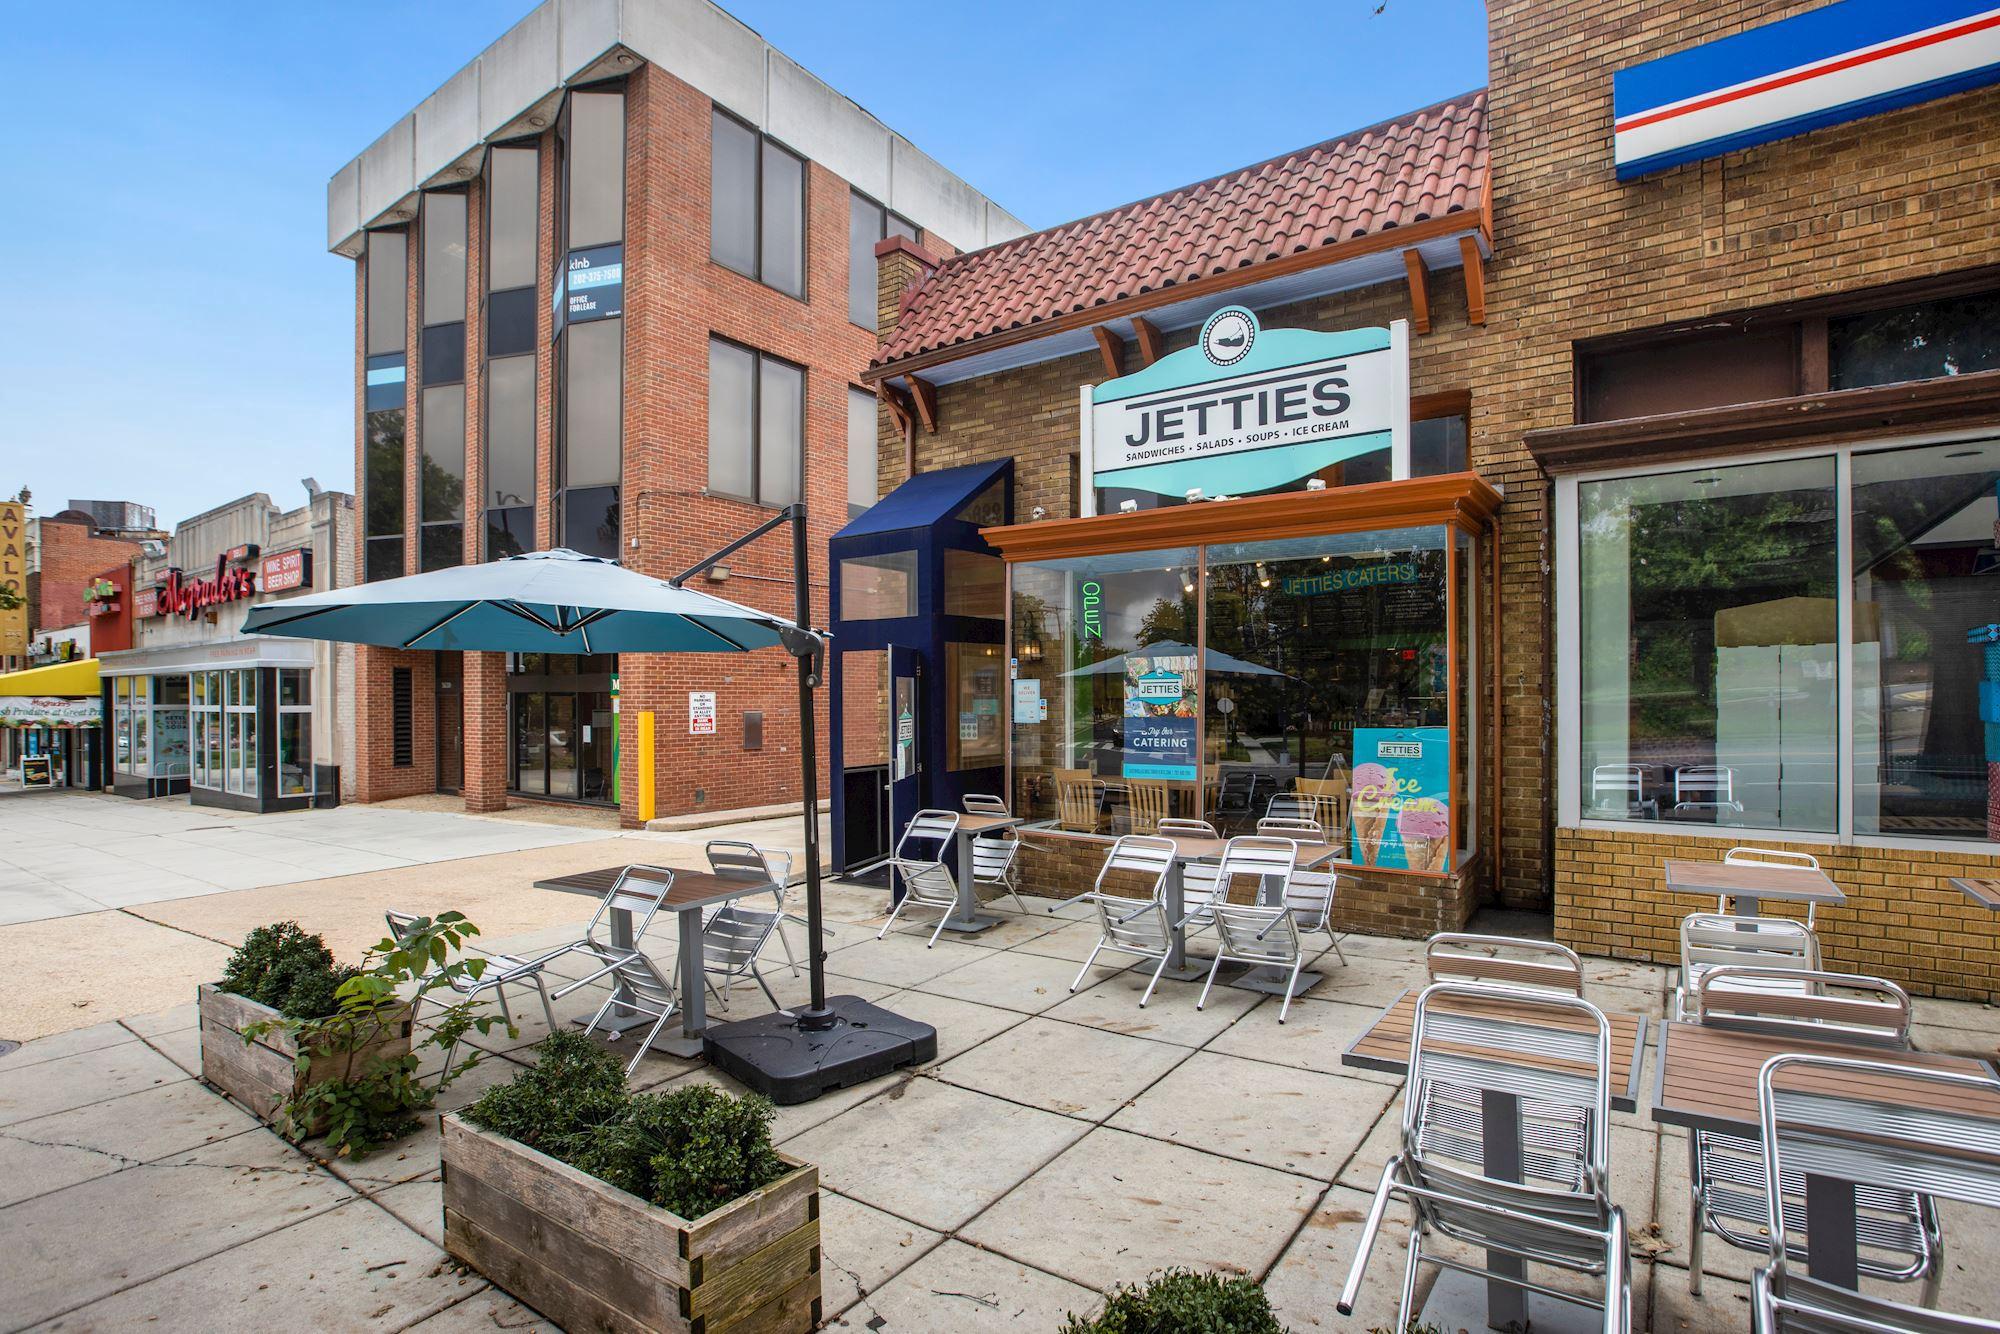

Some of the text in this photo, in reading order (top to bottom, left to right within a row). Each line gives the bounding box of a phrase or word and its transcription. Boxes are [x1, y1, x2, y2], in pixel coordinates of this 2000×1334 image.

[569, 257, 590, 270] klnb
[569, 295, 588, 304] OFFICE
[569, 302, 597, 312] FOR LEASE
[1125, 377, 1351, 447] JETTIES
[1126, 420, 1349, 462] SANDWICHES SALADS SOUPS ICE CREAM
[266, 553, 300, 573] WINE SPIRIT
[267, 570, 300, 589] BEER SHOP
[1286, 572, 1342, 594] JETTIES
[1082, 581, 1102, 639] OPEN
[1141, 685, 1180, 694] JETTIES
[1147, 727, 1174, 738] Try Our
[1133, 737, 1188, 748] CATERING
[1380, 746, 1420, 754] JETTIES
[1383, 767, 1422, 793] Ice
[1357, 785, 1440, 812] Cream
